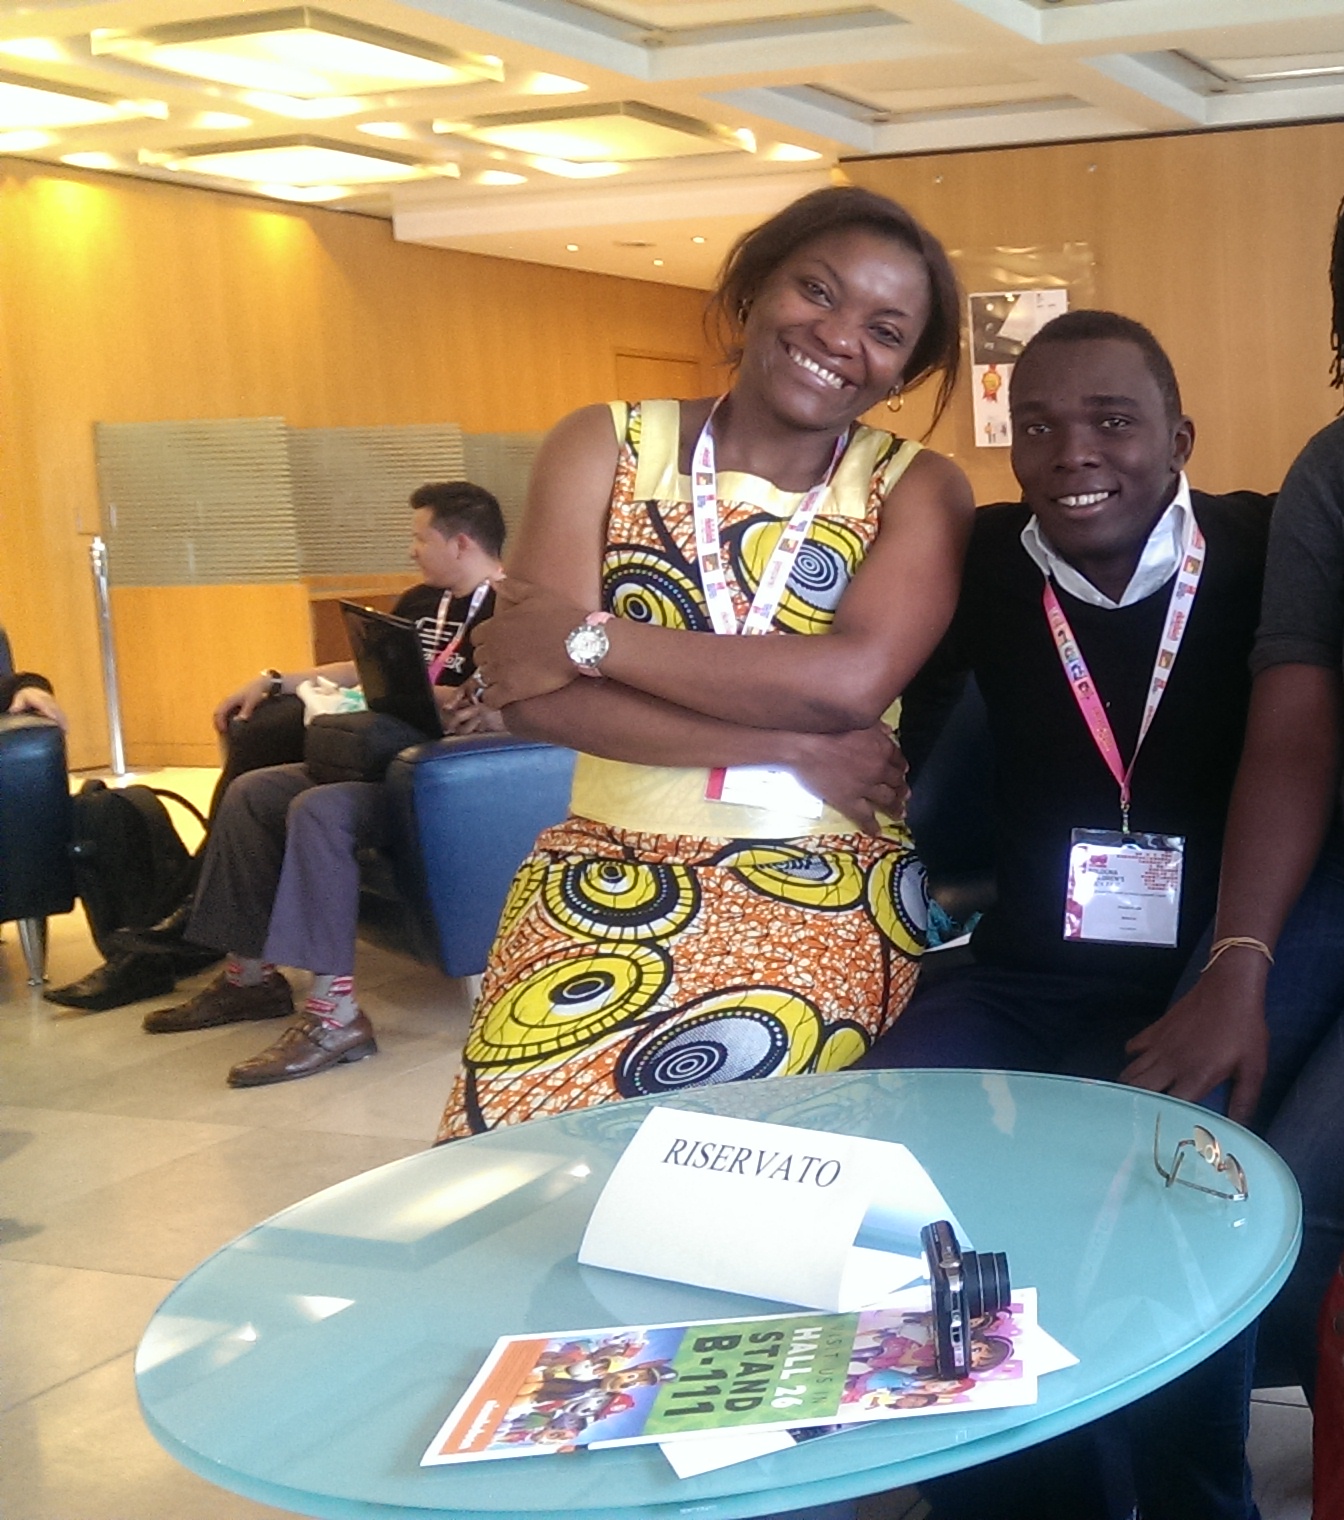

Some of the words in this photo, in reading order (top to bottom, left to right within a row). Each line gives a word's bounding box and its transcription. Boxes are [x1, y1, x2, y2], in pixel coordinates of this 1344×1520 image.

[661, 1138, 842, 1188] RISERVATO
[780, 1326, 823, 1380] HALL
[824, 1324, 844, 1358] VISIT
[663, 1334, 743, 1417] B-111
[725, 1331, 785, 1412] STAND
[816, 1368, 834, 1384] US
[770, 1385, 807, 1409] 26
[811, 1391, 829, 1404] IN
